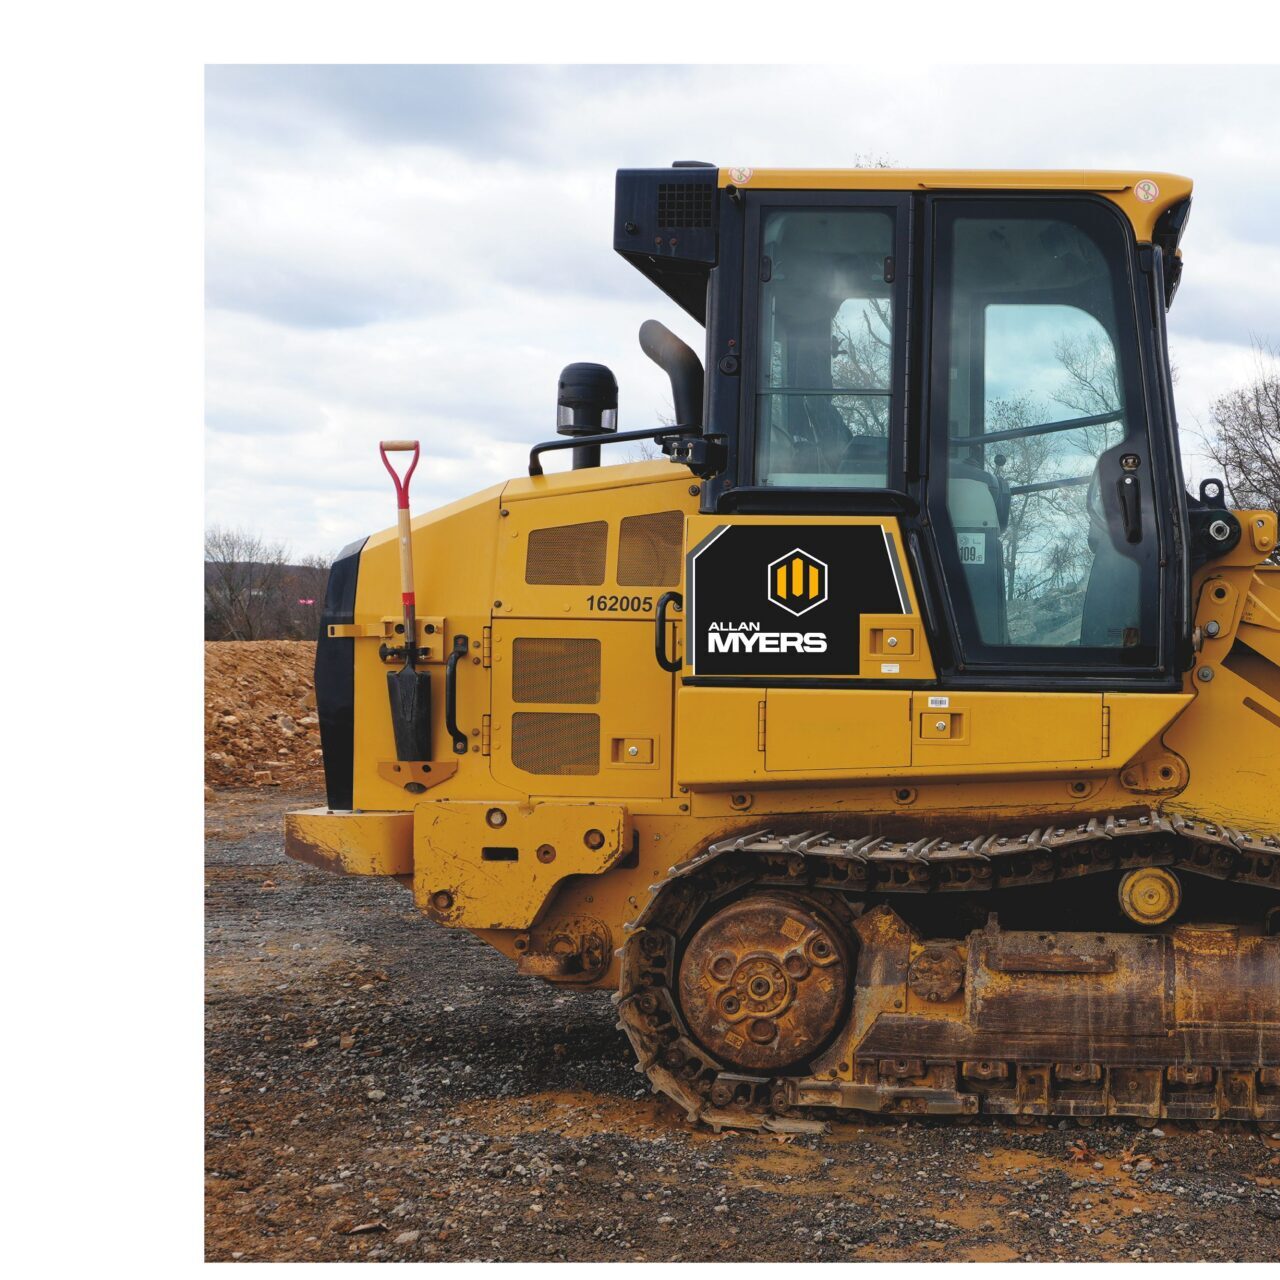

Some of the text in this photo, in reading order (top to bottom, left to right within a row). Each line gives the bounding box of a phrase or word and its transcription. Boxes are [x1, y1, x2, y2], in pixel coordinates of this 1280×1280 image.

[586, 595, 653, 612] 162005
[708, 621, 760, 631] ALLAN
[708, 632, 828, 653] MYERS
